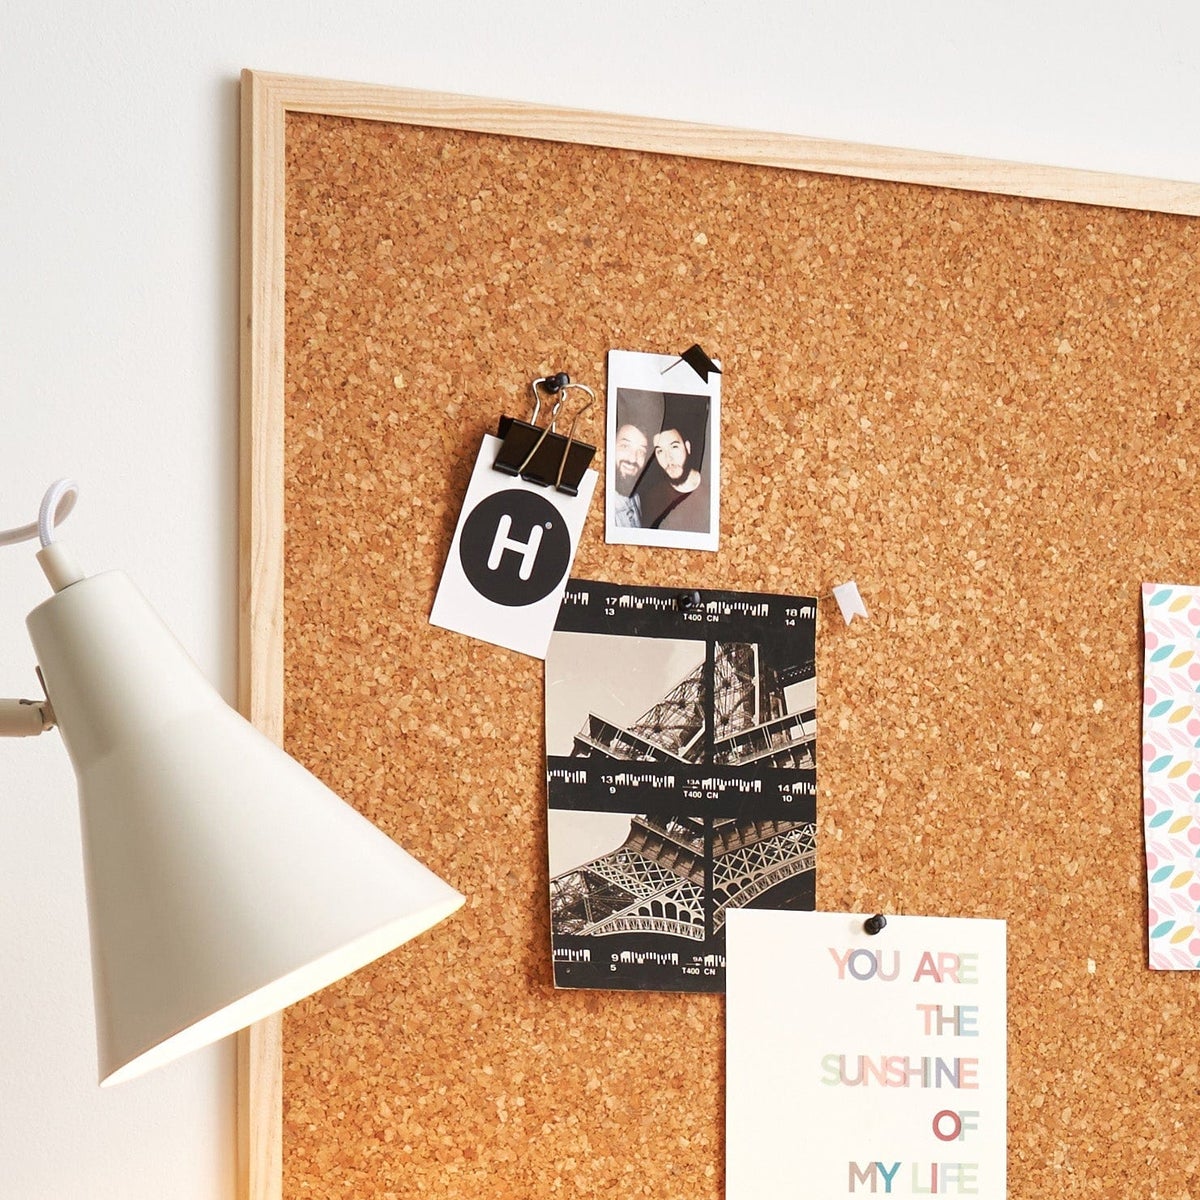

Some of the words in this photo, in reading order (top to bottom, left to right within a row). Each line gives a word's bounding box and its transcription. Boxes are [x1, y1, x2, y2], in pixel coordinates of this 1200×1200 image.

[487, 514, 544, 581] H
[605, 597, 617, 605] 17
[604, 608, 615, 616] 13
[785, 608, 798, 617] 18
[683, 613, 702, 621] T400
[706, 614, 719, 622] CN
[601, 775, 613, 784] 13
[609, 786, 617, 794] 9
[778, 784, 790, 792] 14
[683, 790, 702, 799] T400
[706, 791, 719, 799] CN
[782, 795, 793, 803] 10
[611, 954, 619, 962] 9
[610, 964, 617, 972] 5
[828, 948, 900, 982] YOU
[913, 951, 979, 984] ARE
[682, 967, 700, 975] T400
[703, 968, 716, 976] CN
[916, 1003, 979, 1037] THE
[820, 1054, 979, 1089] SUNSHINE
[932, 1109, 980, 1142] OF
[848, 1161, 901, 1193] MY
[911, 1162, 979, 1194] LIFE
